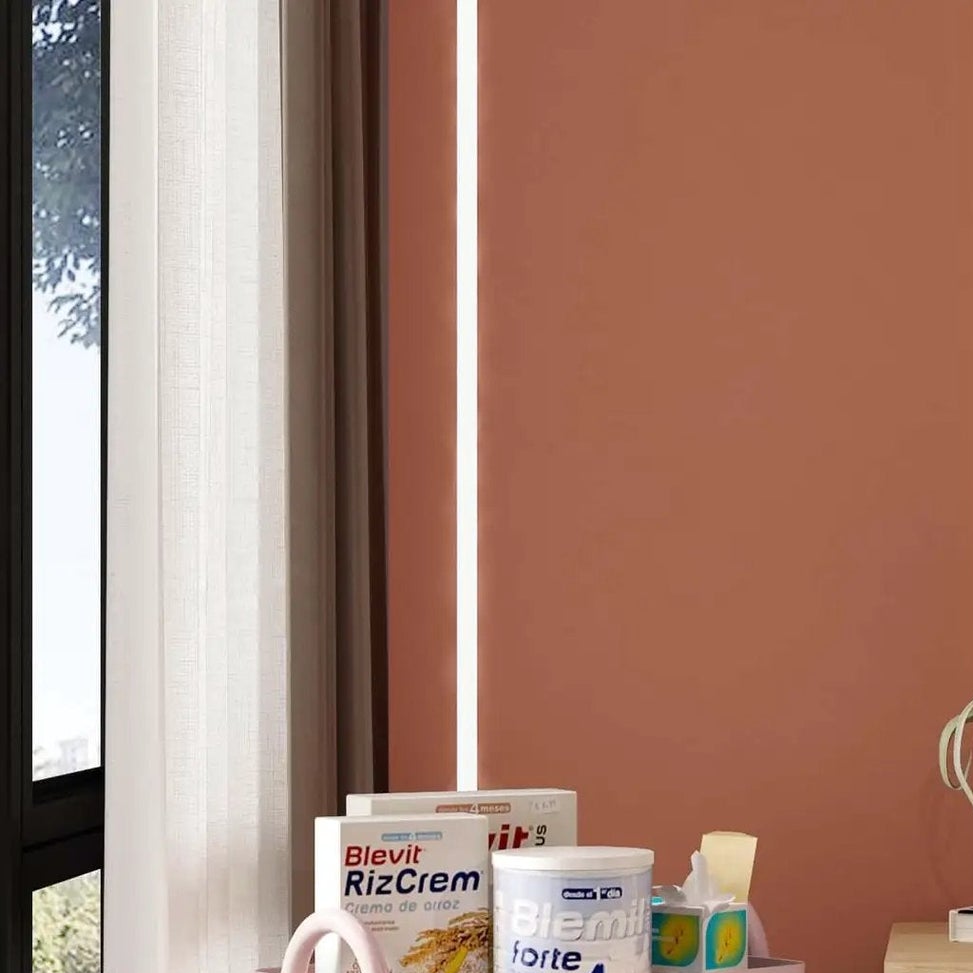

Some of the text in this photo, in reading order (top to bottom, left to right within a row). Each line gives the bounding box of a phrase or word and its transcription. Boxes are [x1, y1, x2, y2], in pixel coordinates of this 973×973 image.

[344, 844, 422, 867] Blevit
[344, 868, 481, 897] RizCrem
[344, 902, 393, 915] Crema
[399, 900, 418, 912] de
[512, 897, 646, 942] Blemil
[512, 940, 582, 971] forte
